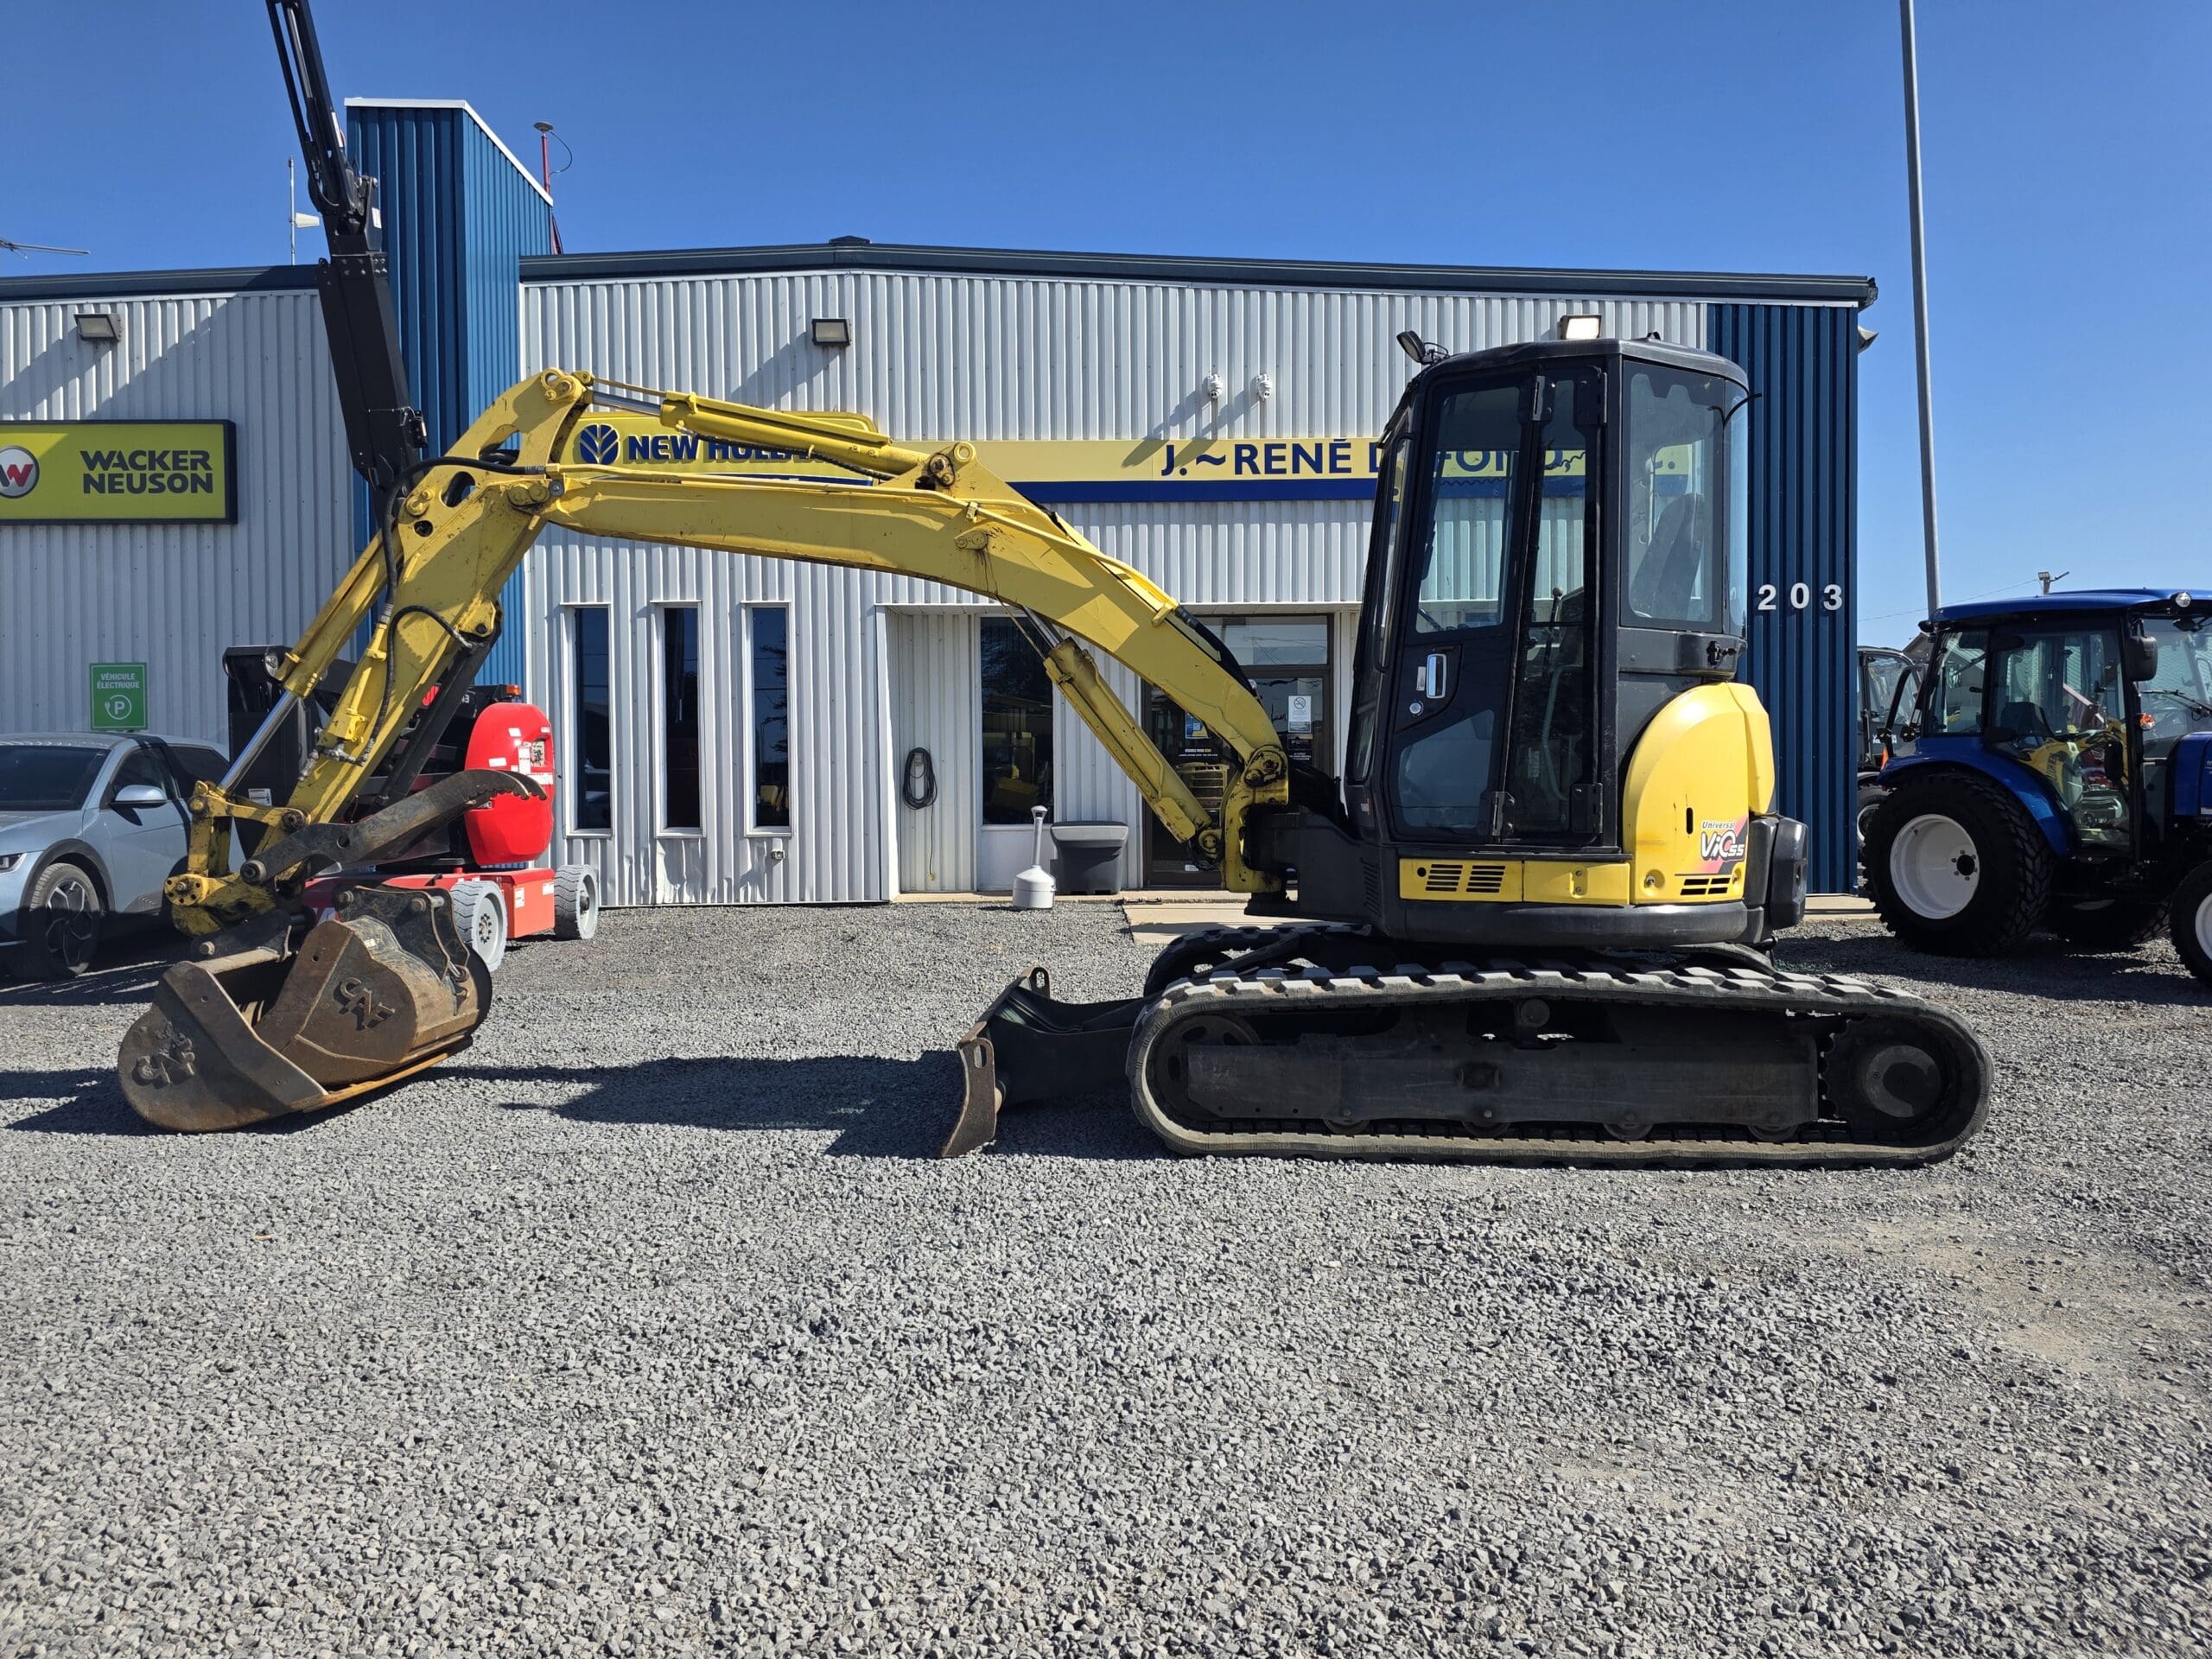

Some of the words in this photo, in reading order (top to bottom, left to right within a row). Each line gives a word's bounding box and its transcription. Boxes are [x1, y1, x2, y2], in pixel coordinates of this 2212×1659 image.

[628, 435, 699, 460] NEW
[80, 450, 213, 471] WACKER
[83, 473, 213, 494] NEUSON
[97, 679, 140, 689] ÉLECTRIQUE
[101, 671, 136, 680] VÉHICULE
